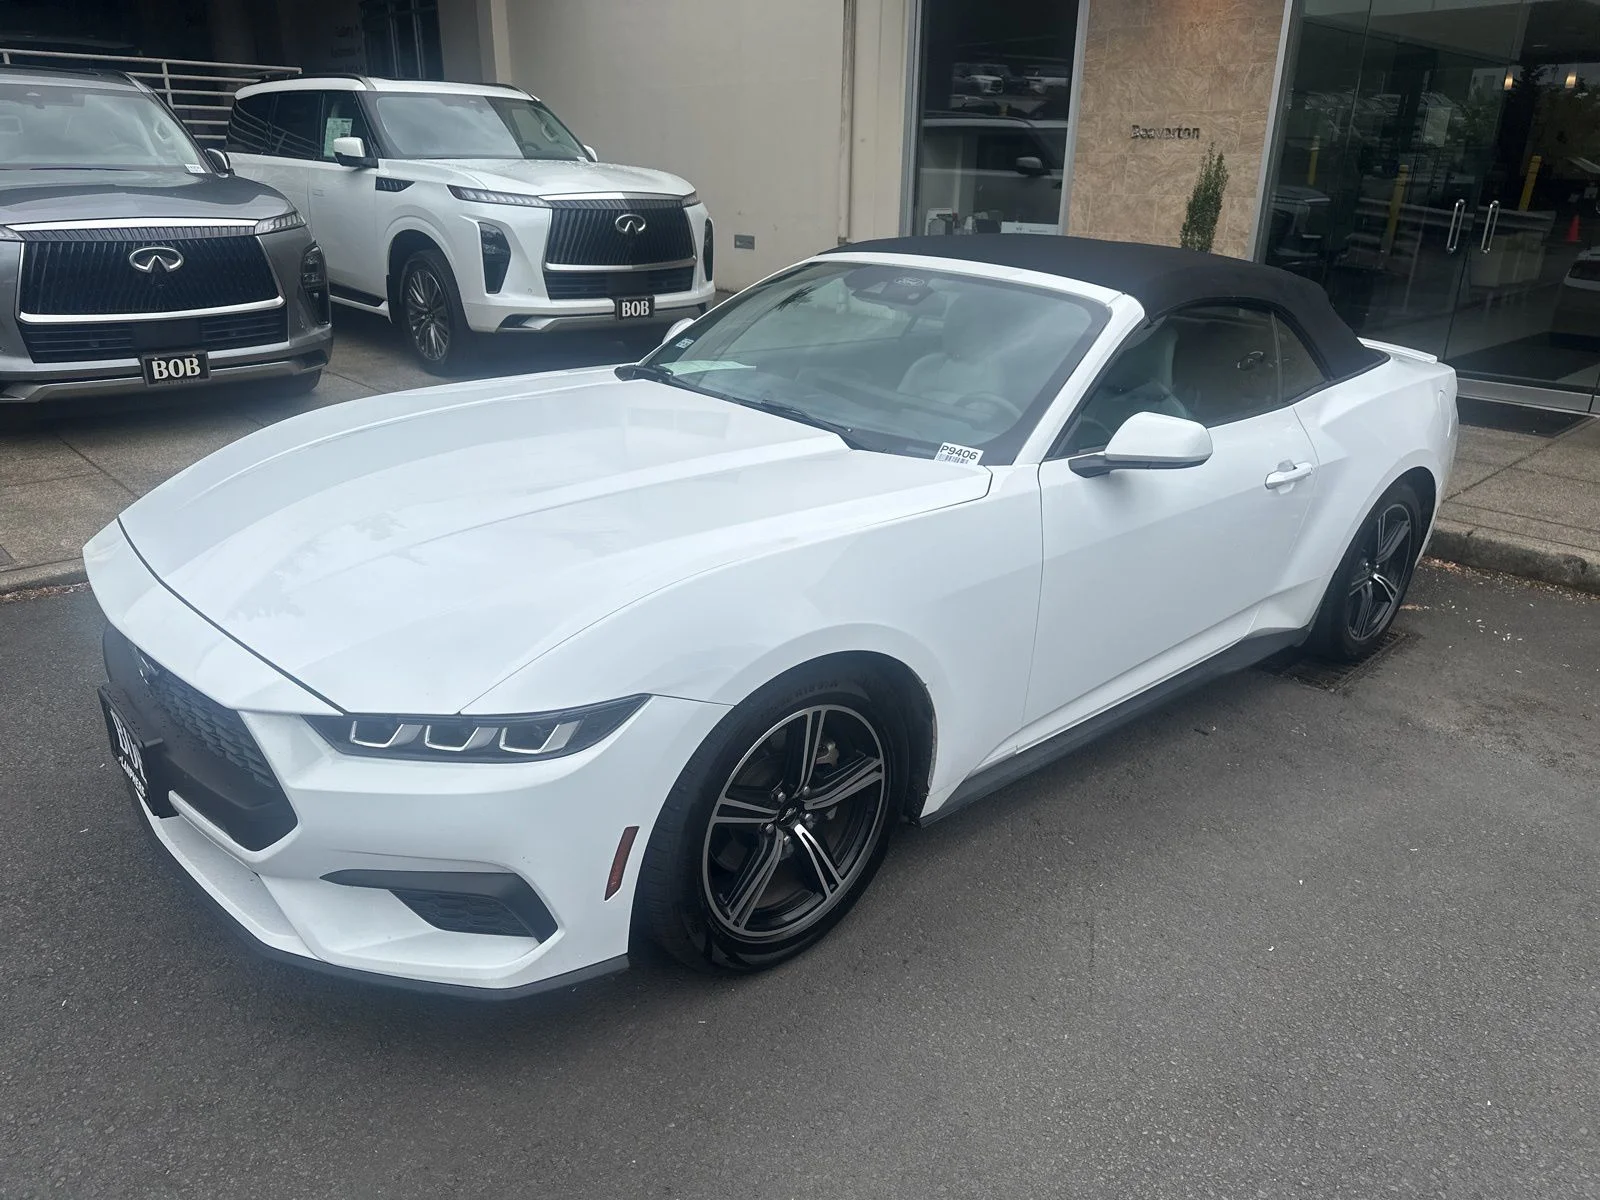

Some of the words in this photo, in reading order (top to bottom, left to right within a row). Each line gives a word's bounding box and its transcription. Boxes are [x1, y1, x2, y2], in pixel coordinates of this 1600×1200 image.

[1131, 124, 1200, 140] Beaverton
[621, 300, 650, 317] BOB
[152, 358, 201, 380] BOB
[940, 445, 978, 460] P9406
